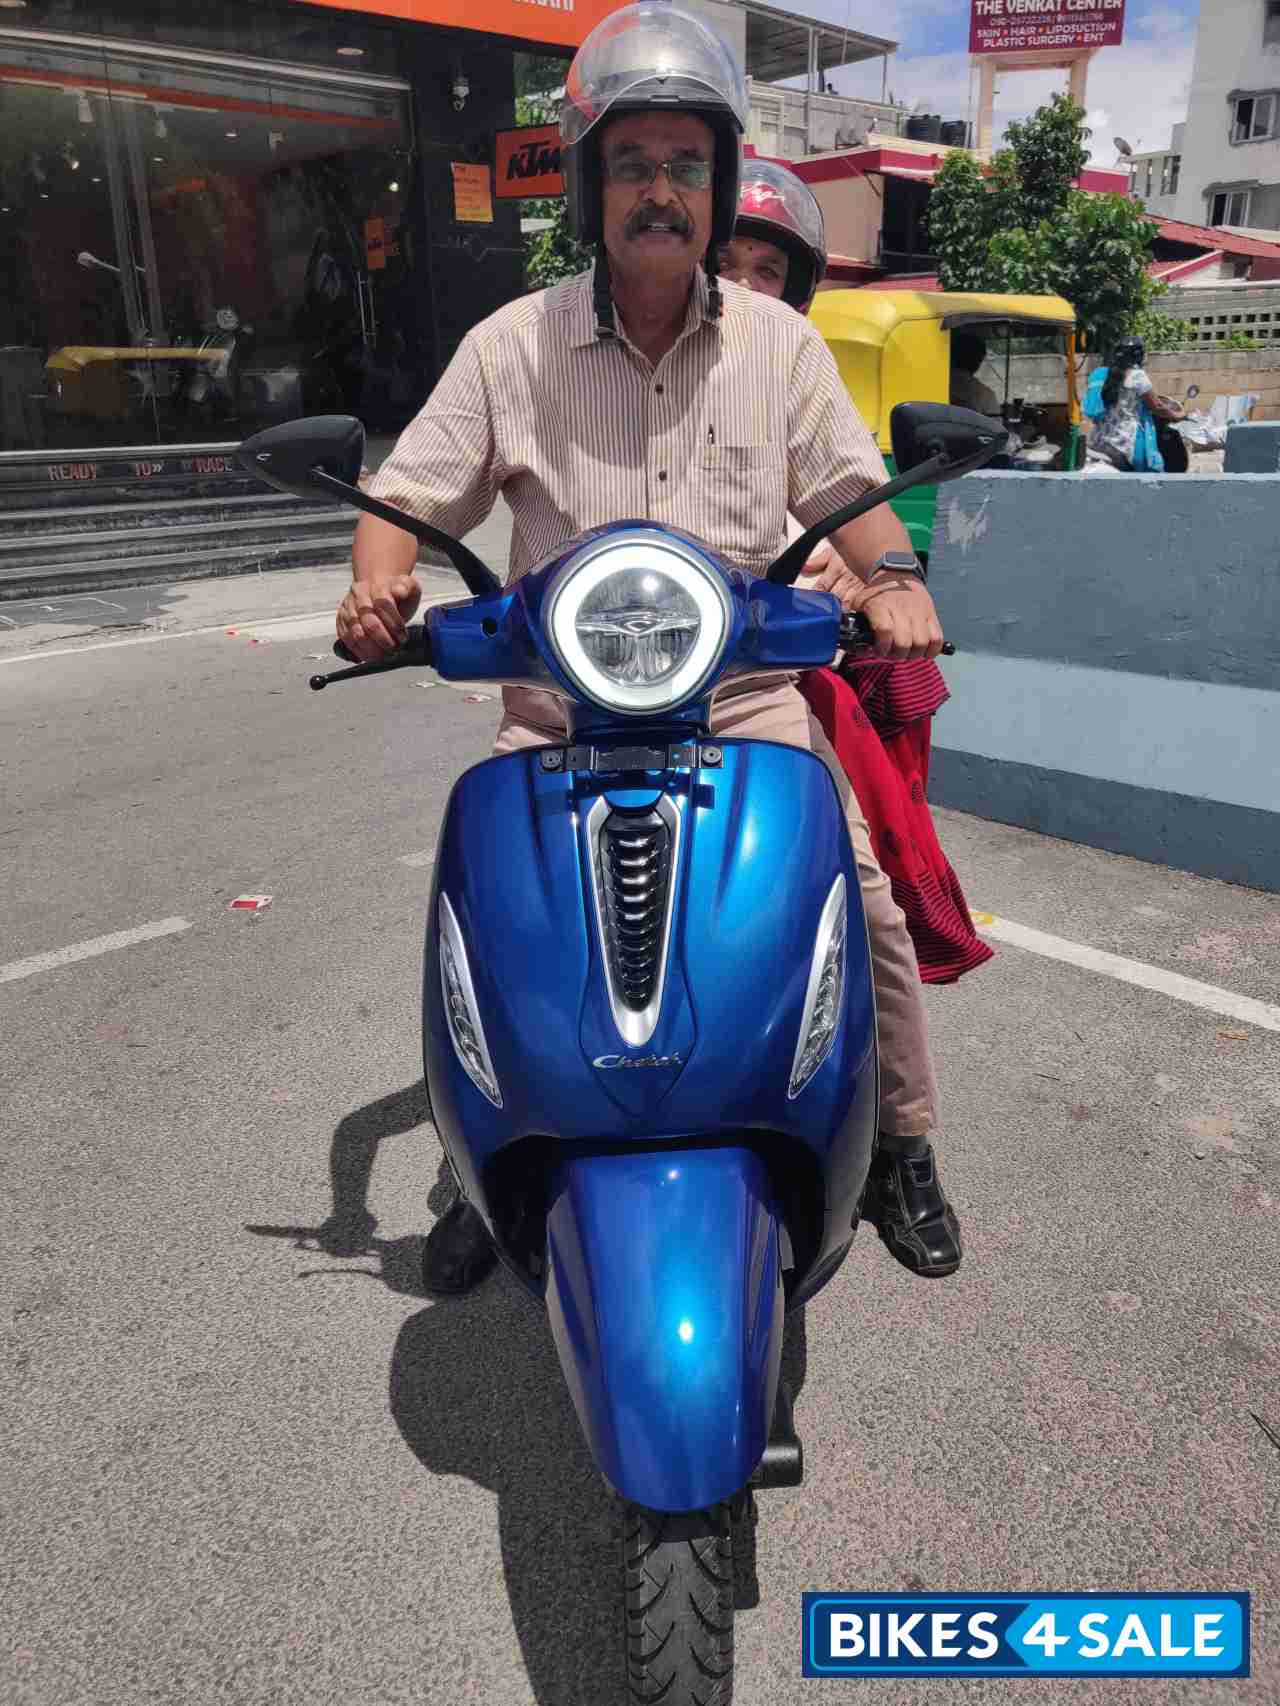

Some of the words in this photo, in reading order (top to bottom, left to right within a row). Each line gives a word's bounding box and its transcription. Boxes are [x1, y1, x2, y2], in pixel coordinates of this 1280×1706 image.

[975, 1, 1003, 15] THE
[1007, 0, 1064, 13] VENKAT
[1068, 0, 1123, 12] CENTER
[977, 28, 1001, 39] SKIN
[1010, 26, 1036, 37] HAIR
[1047, 21, 1116, 34] LIPOSUCTION
[983, 36, 1025, 48] PLASTIC
[1028, 33, 1075, 46] SURGERY
[1083, 32, 1105, 42] ENT
